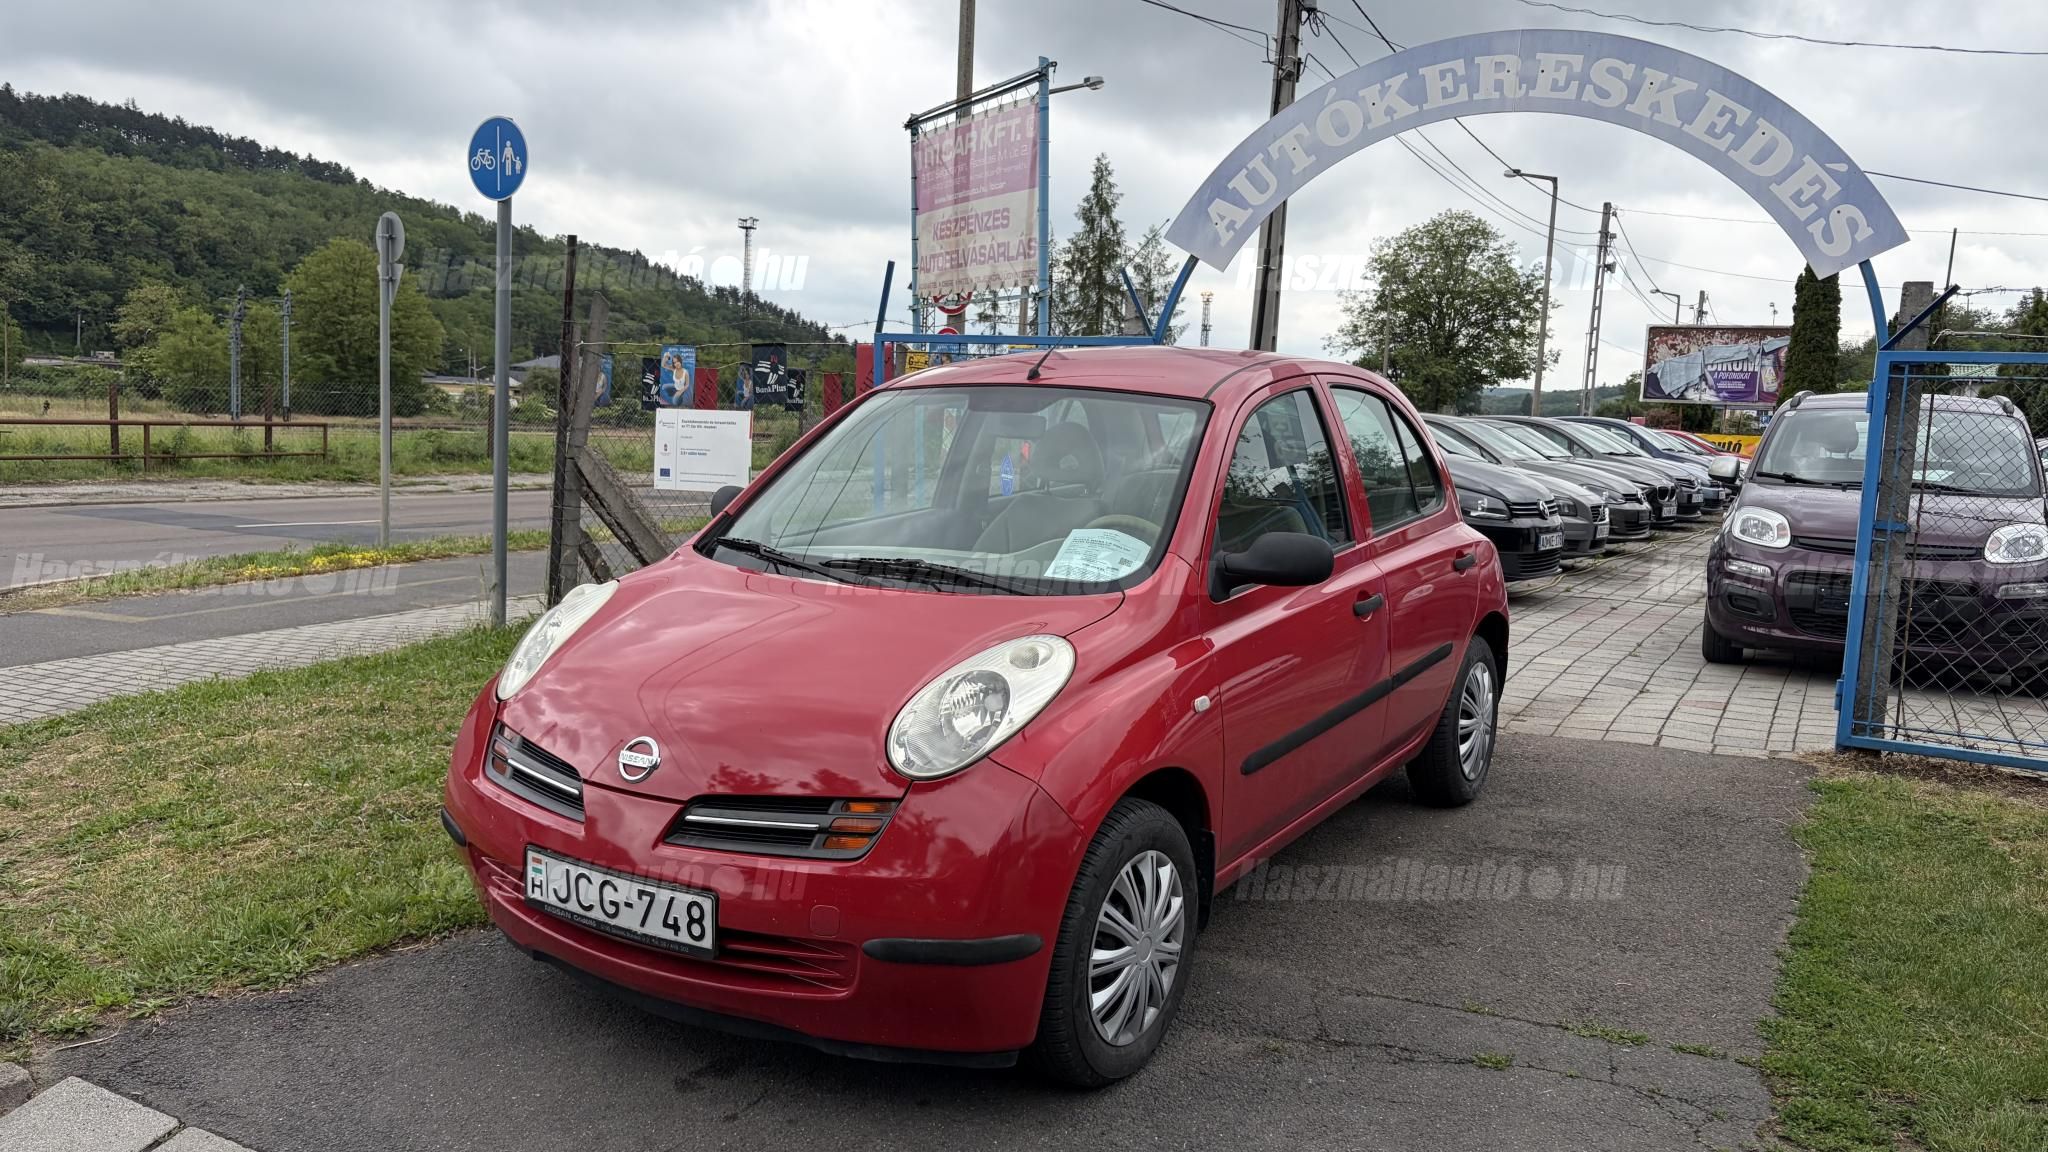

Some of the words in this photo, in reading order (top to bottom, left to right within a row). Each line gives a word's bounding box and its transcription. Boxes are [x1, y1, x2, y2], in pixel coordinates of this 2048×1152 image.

[1205, 52, 1873, 257] AUTÓKERESKEDÉS
[932, 207, 1010, 241] KÉSZPÉNZES
[920, 232, 1037, 274] AUTÓFELVÁSÁRLÁS
[755, 384, 786, 394] BankPlus
[621, 752, 655, 766] NISSAN
[530, 876, 543, 897] H
[553, 868, 706, 942] JCG-748
